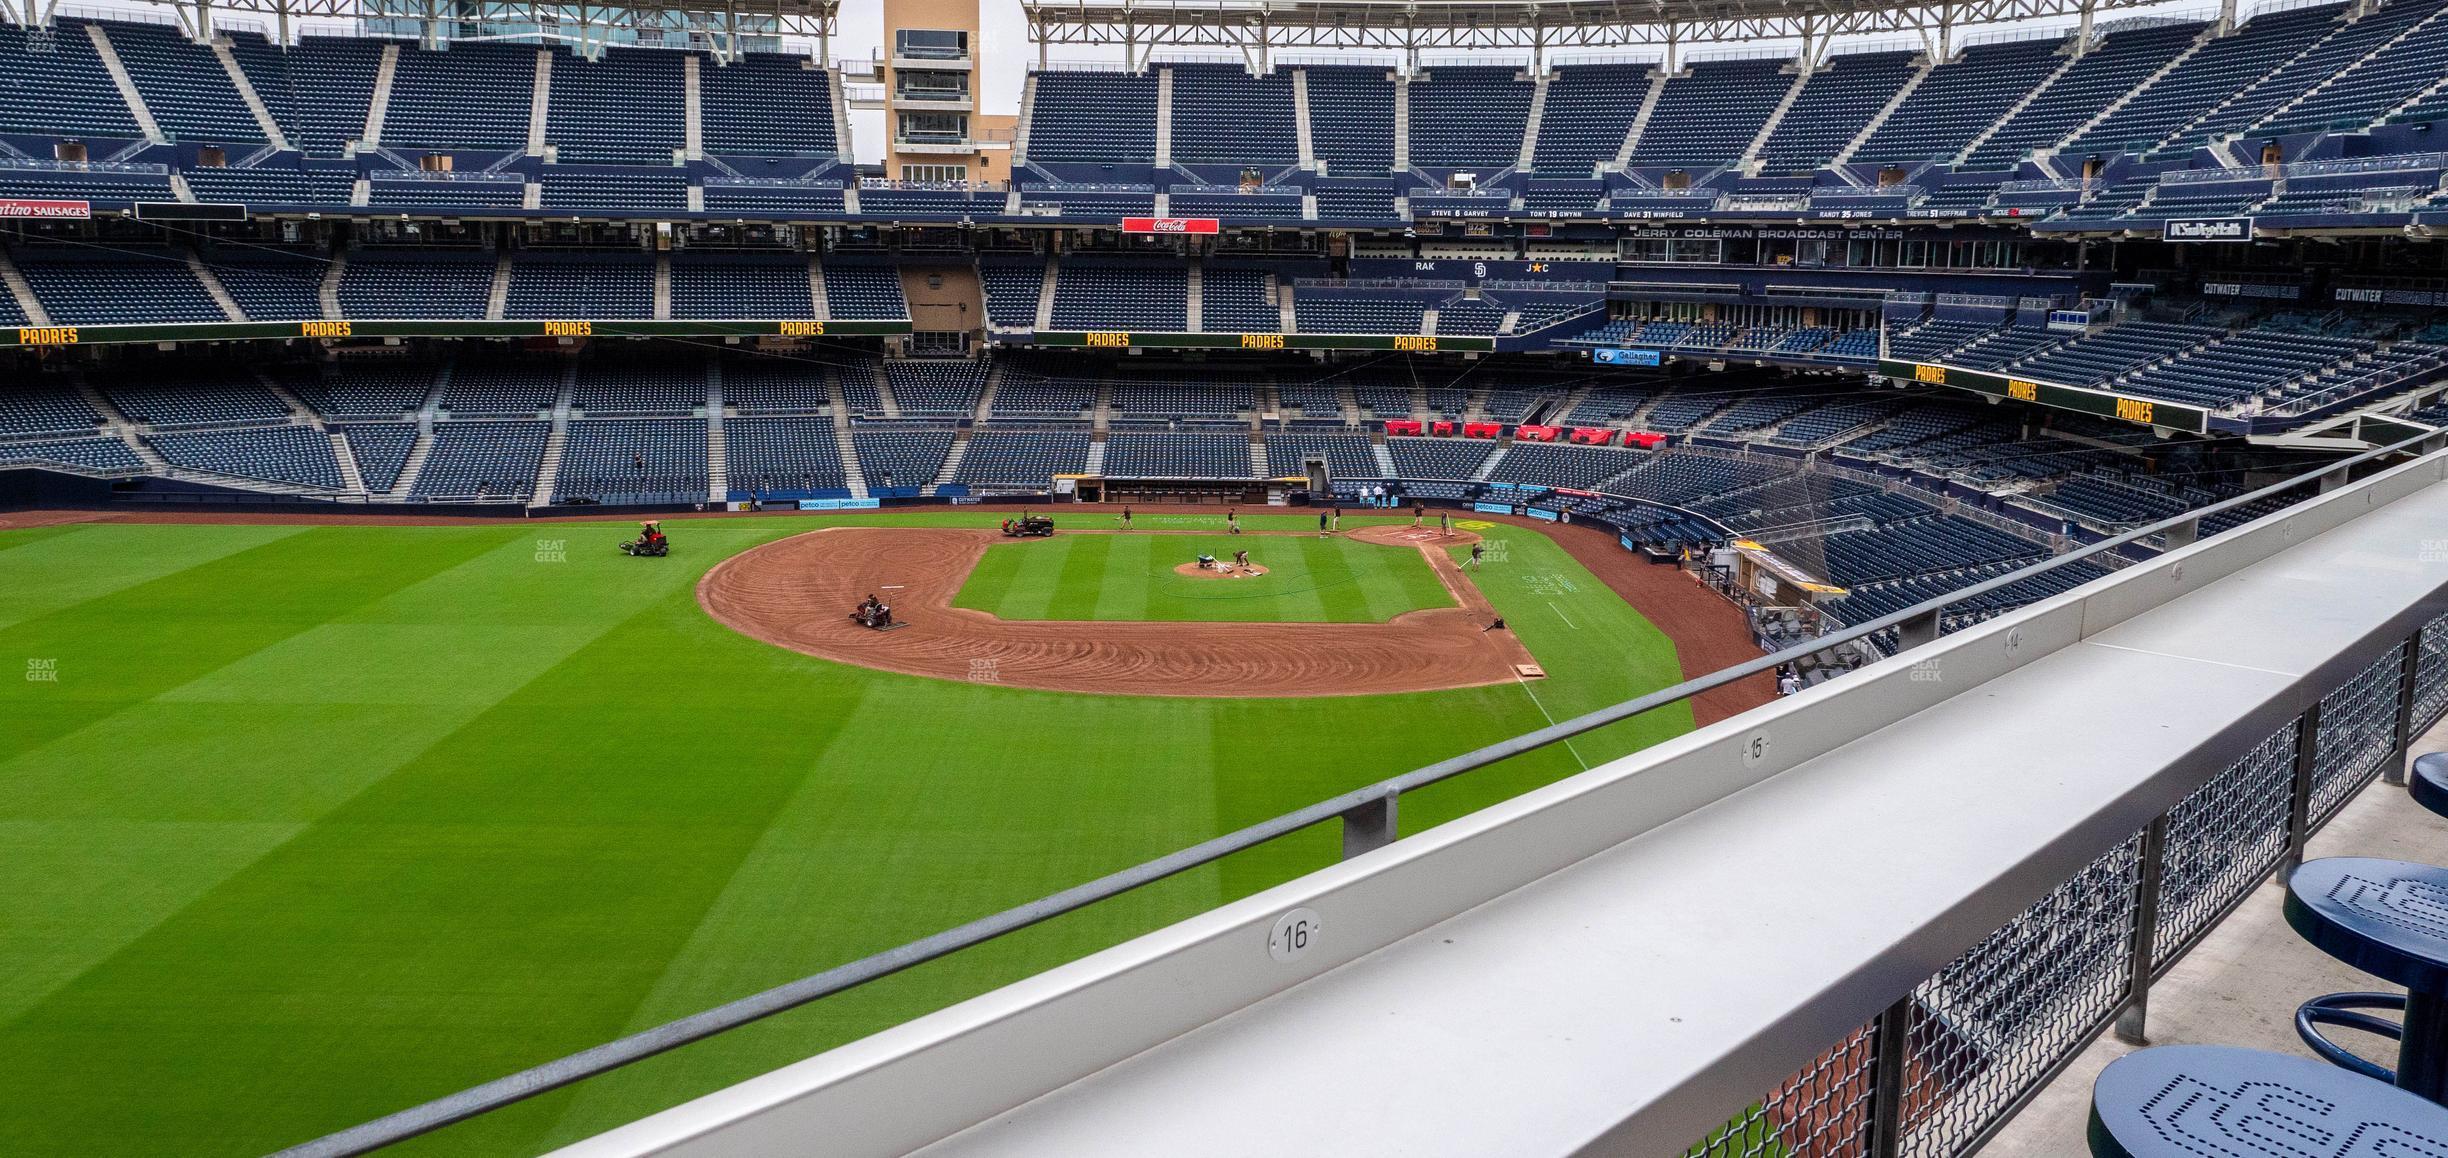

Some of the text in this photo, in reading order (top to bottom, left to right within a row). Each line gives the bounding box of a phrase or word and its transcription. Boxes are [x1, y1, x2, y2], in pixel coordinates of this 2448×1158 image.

[34, 206, 88, 216] SAUSAGES
[1930, 209, 1938, 217] 51
[1634, 229, 1904, 239] JERRY COLEMAN BROADCAST CENTER
[1415, 262, 1435, 271] RAK
[2203, 283, 2241, 295] CUTWATER
[2335, 288, 2383, 302] CUTWATER
[302, 321, 351, 336] PADRES
[545, 321, 591, 336] PADRES
[780, 321, 824, 335] PADRES
[20, 328, 78, 344] PADRES
[1087, 333, 1129, 346] PADRES
[1242, 334, 1284, 348] PADRES
[1394, 336, 1436, 350] PADRES
[1915, 364, 1945, 384] PADRES
[2008, 379, 2037, 400] PADRES
[2116, 397, 2153, 422] PADRES
[801, 501, 820, 509] petco
[841, 500, 860, 508] petco
[1751, 736, 1762, 760] 15
[1284, 920, 1307, 953] 16
